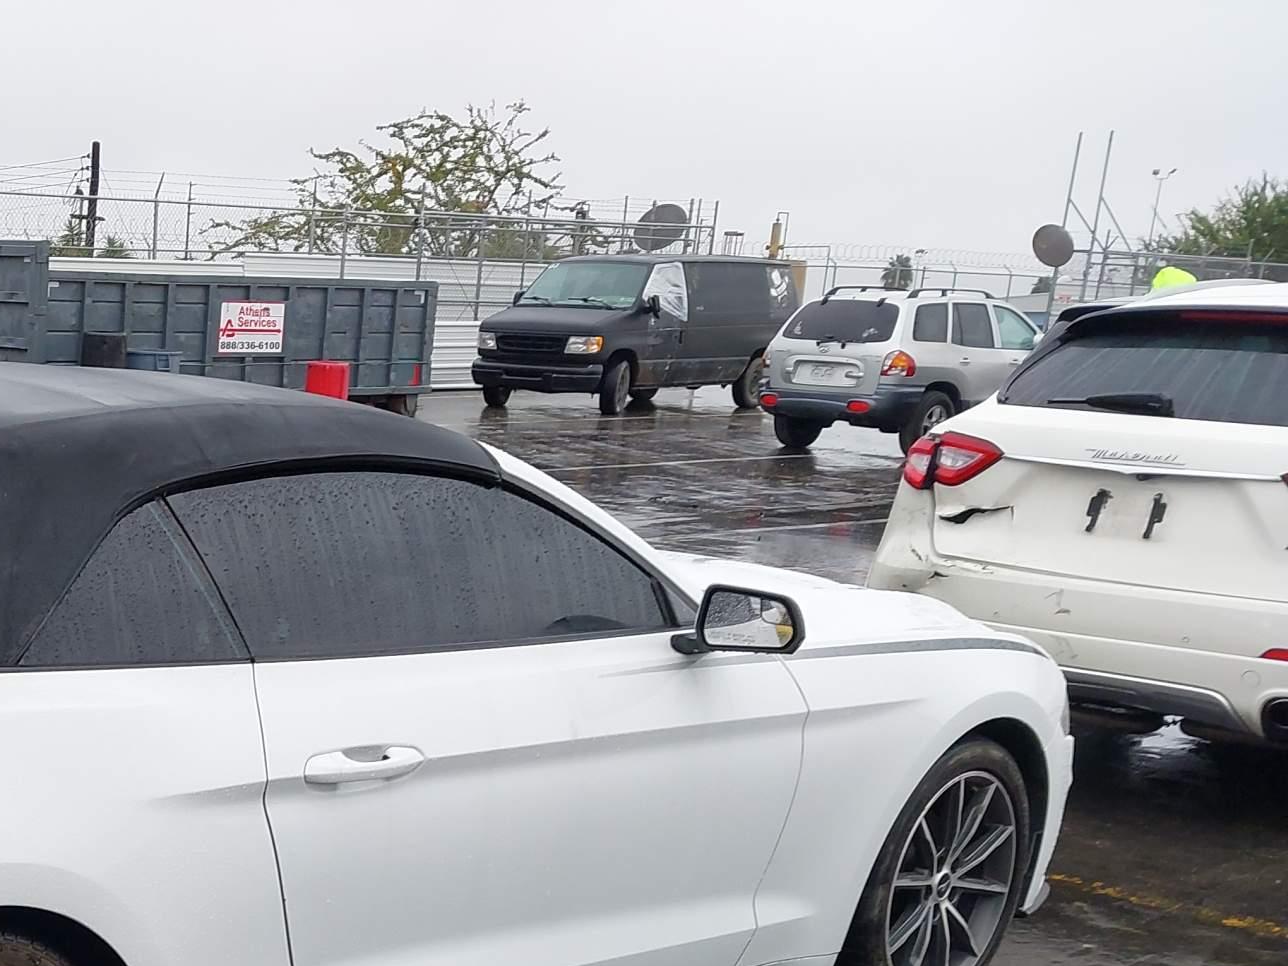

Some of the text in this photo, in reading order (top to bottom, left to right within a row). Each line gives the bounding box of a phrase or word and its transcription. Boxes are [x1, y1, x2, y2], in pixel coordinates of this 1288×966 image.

[238, 306, 271, 317] Athens
[237, 316, 277, 328] Services
[220, 341, 281, 350] 888/336-6100
